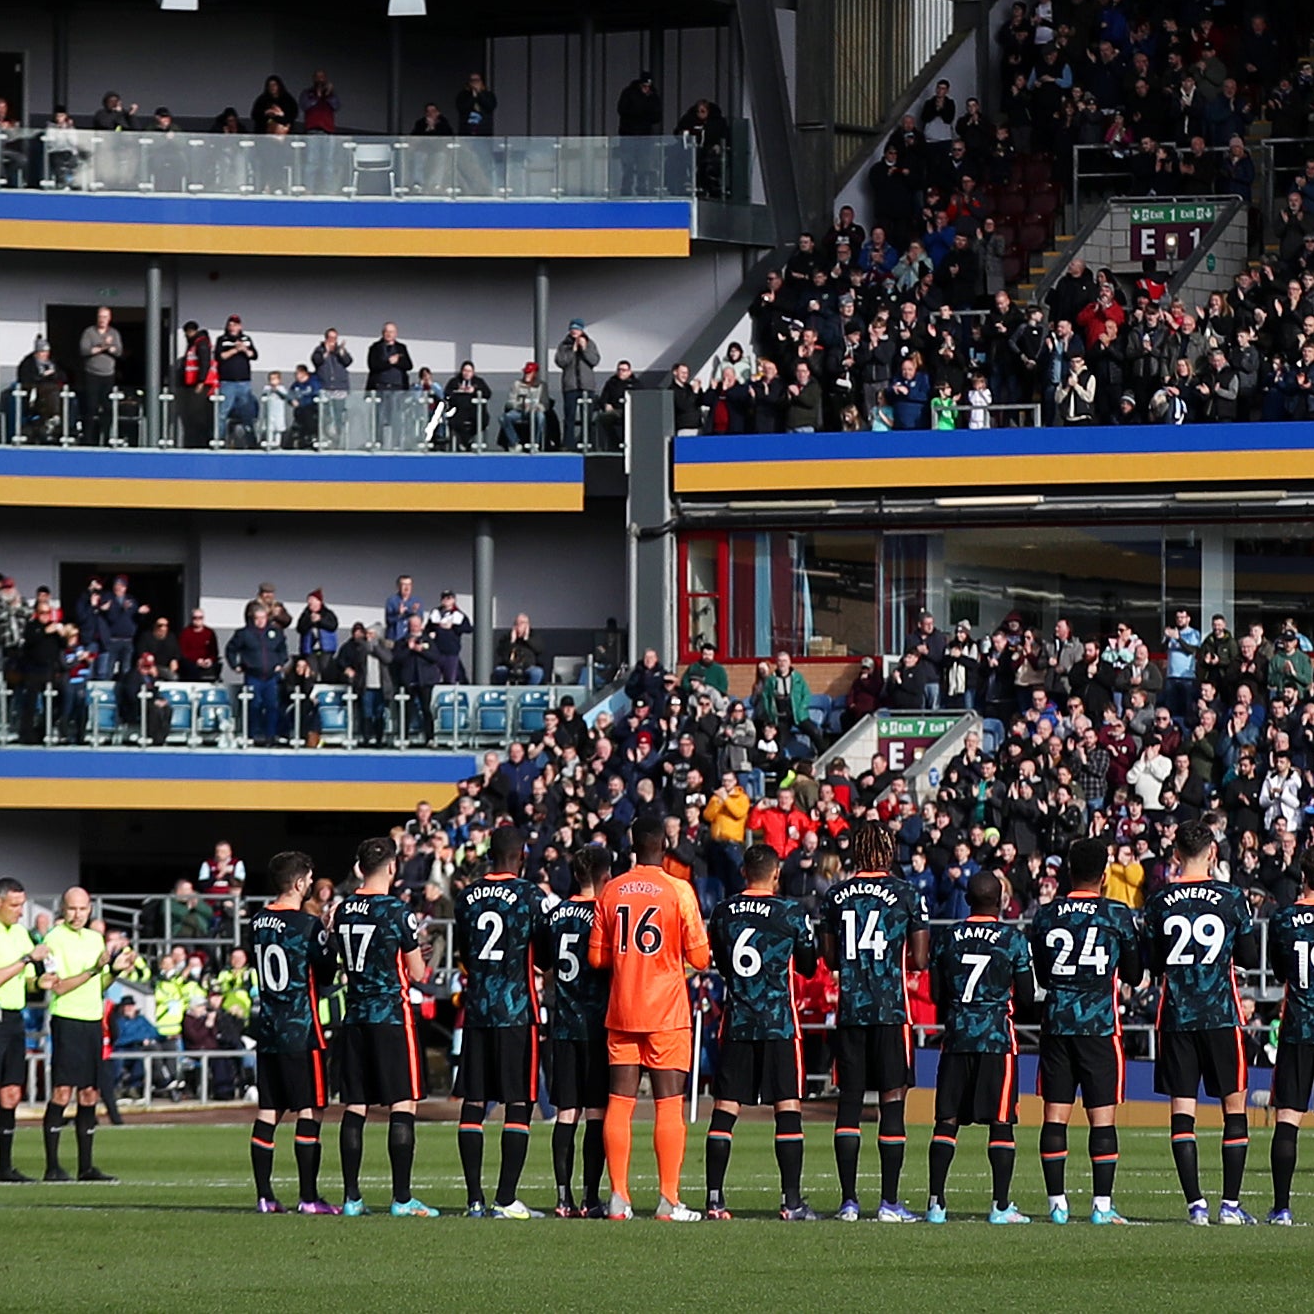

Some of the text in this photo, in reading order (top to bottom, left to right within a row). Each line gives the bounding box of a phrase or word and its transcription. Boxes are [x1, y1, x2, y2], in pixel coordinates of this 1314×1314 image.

[1169, 209, 1176, 222] 1
[1140, 228, 1200, 255] E 1
[917, 721, 926, 735] 7
[889, 742, 905, 770] E
[466, 886, 518, 906] RÜDIGER
[618, 882, 663, 896] MENDY
[834, 883, 898, 906] CHALOBAH
[1164, 888, 1223, 906] HAVERTZ
[344, 899, 370, 915] SAÚL
[728, 902, 771, 918] T.SILVA
[1058, 902, 1098, 916] JAMES
[477, 911, 504, 961] 2
[616, 904, 663, 956] 16
[842, 910, 888, 960] 14
[954, 927, 1002, 944] KANTÉ
[1163, 913, 1226, 965] 29
[338, 924, 376, 972] 17
[558, 933, 580, 982] 5
[732, 928, 762, 978] 6
[1046, 927, 1110, 976] 24
[254, 944, 289, 992] 10
[961, 954, 992, 1003] 7
